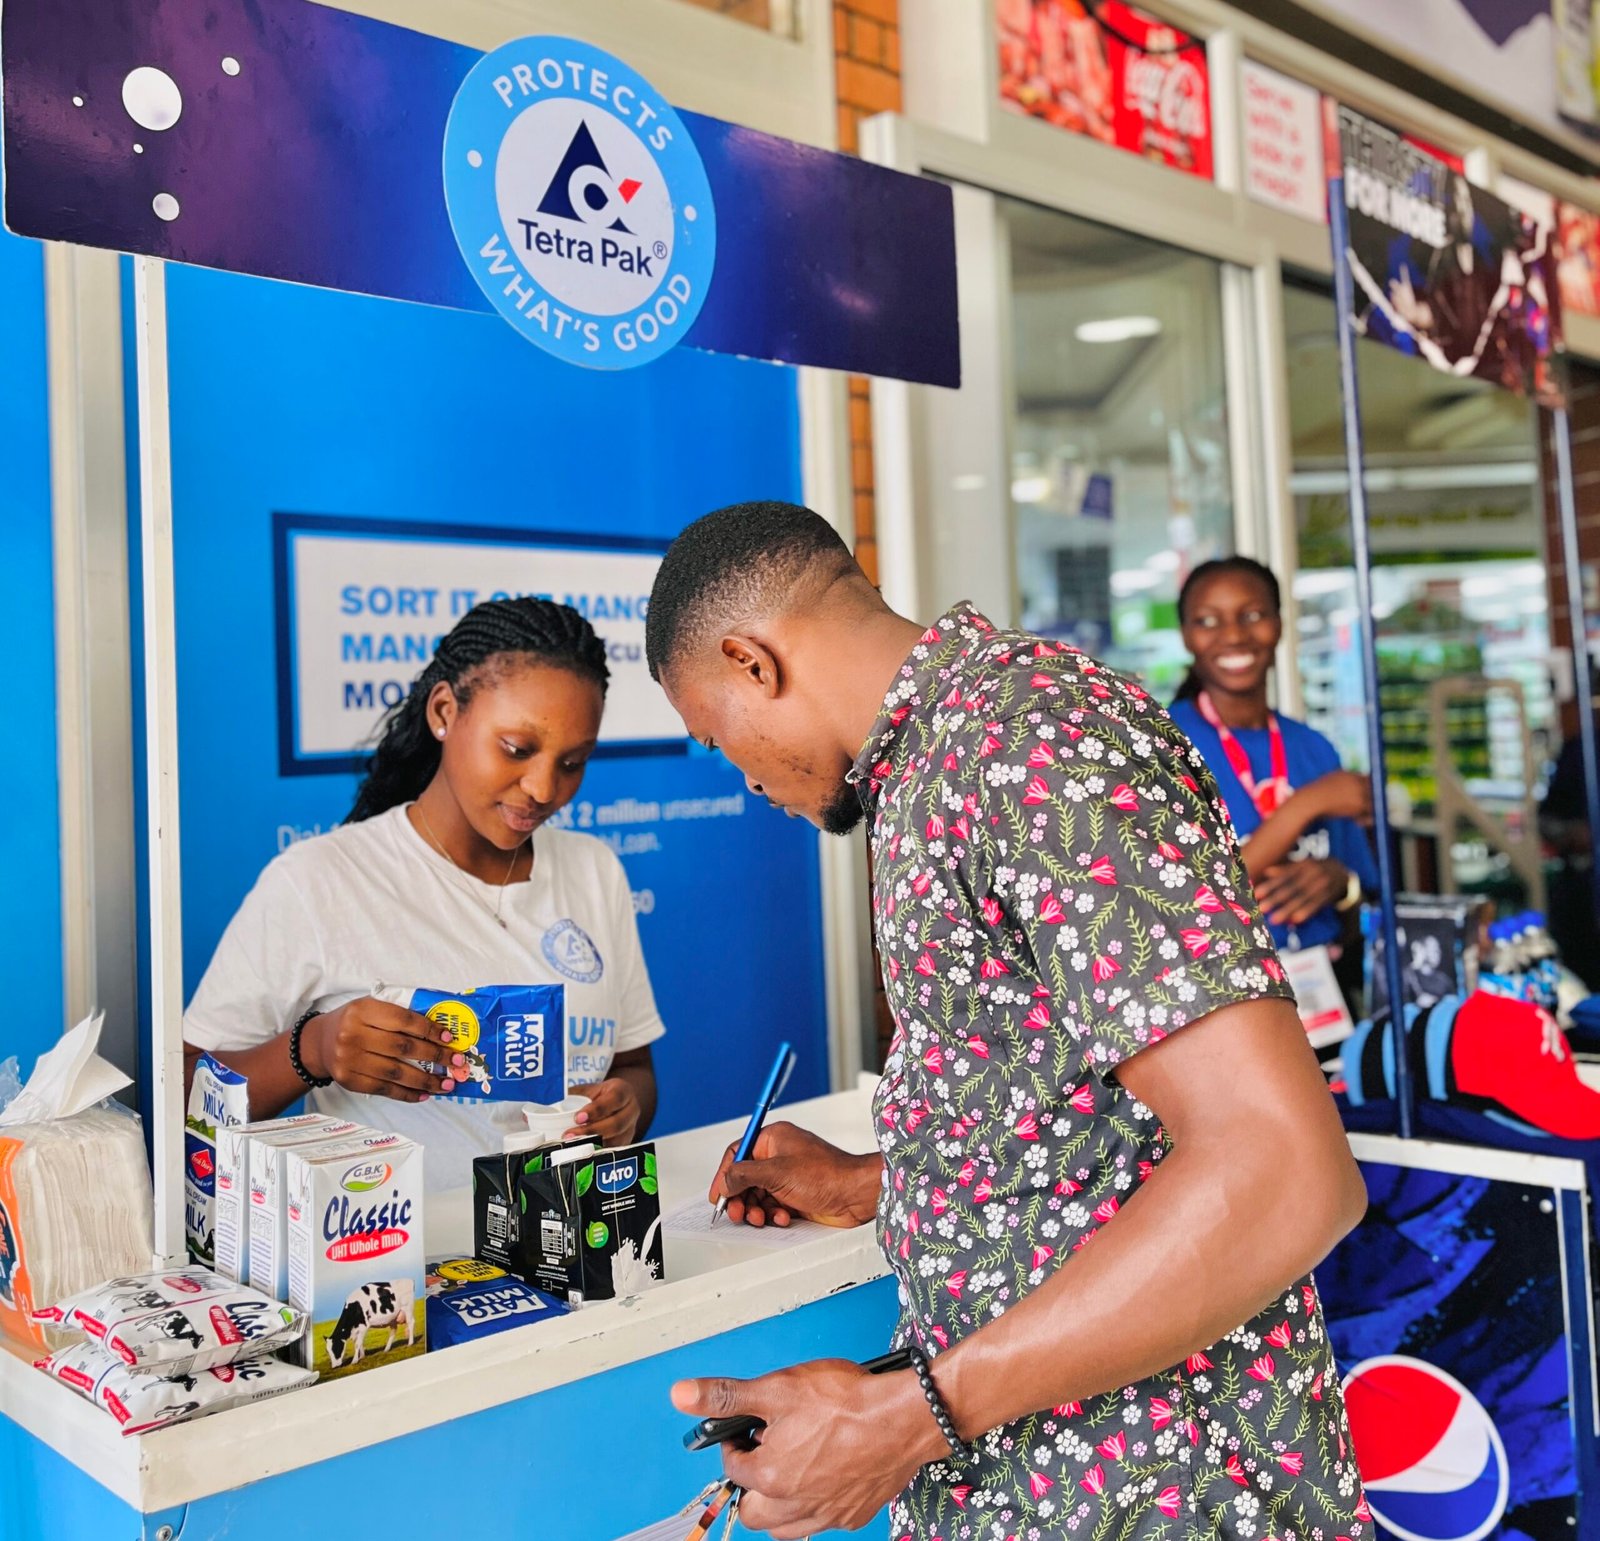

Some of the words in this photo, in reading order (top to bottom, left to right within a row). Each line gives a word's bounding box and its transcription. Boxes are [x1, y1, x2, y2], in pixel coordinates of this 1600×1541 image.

[491, 57, 674, 151] PROTECTS
[1344, 165, 1389, 224] FOR
[1390, 186, 1446, 249] MORE
[517, 217, 594, 265] Tetra
[479, 233, 600, 352] WHAT'S
[613, 273, 692, 352] GOOD
[341, 585, 438, 617] SORT
[451, 589, 478, 616] IT
[577, 802, 594, 828] 2
[460, 1021, 470, 1039] UHT
[569, 1016, 616, 1048] UHT
[524, 1020, 540, 1073] LATO
[203, 1090, 226, 1125] MILK
[363, 1135, 398, 1146] Classic
[601, 1165, 634, 1185] LATO
[323, 1189, 412, 1242] Classic
[331, 1243, 348, 1260] UHT
[350, 1237, 380, 1256] Whole
[381, 1233, 404, 1249] Milk
[466, 1295, 538, 1319] LATO
